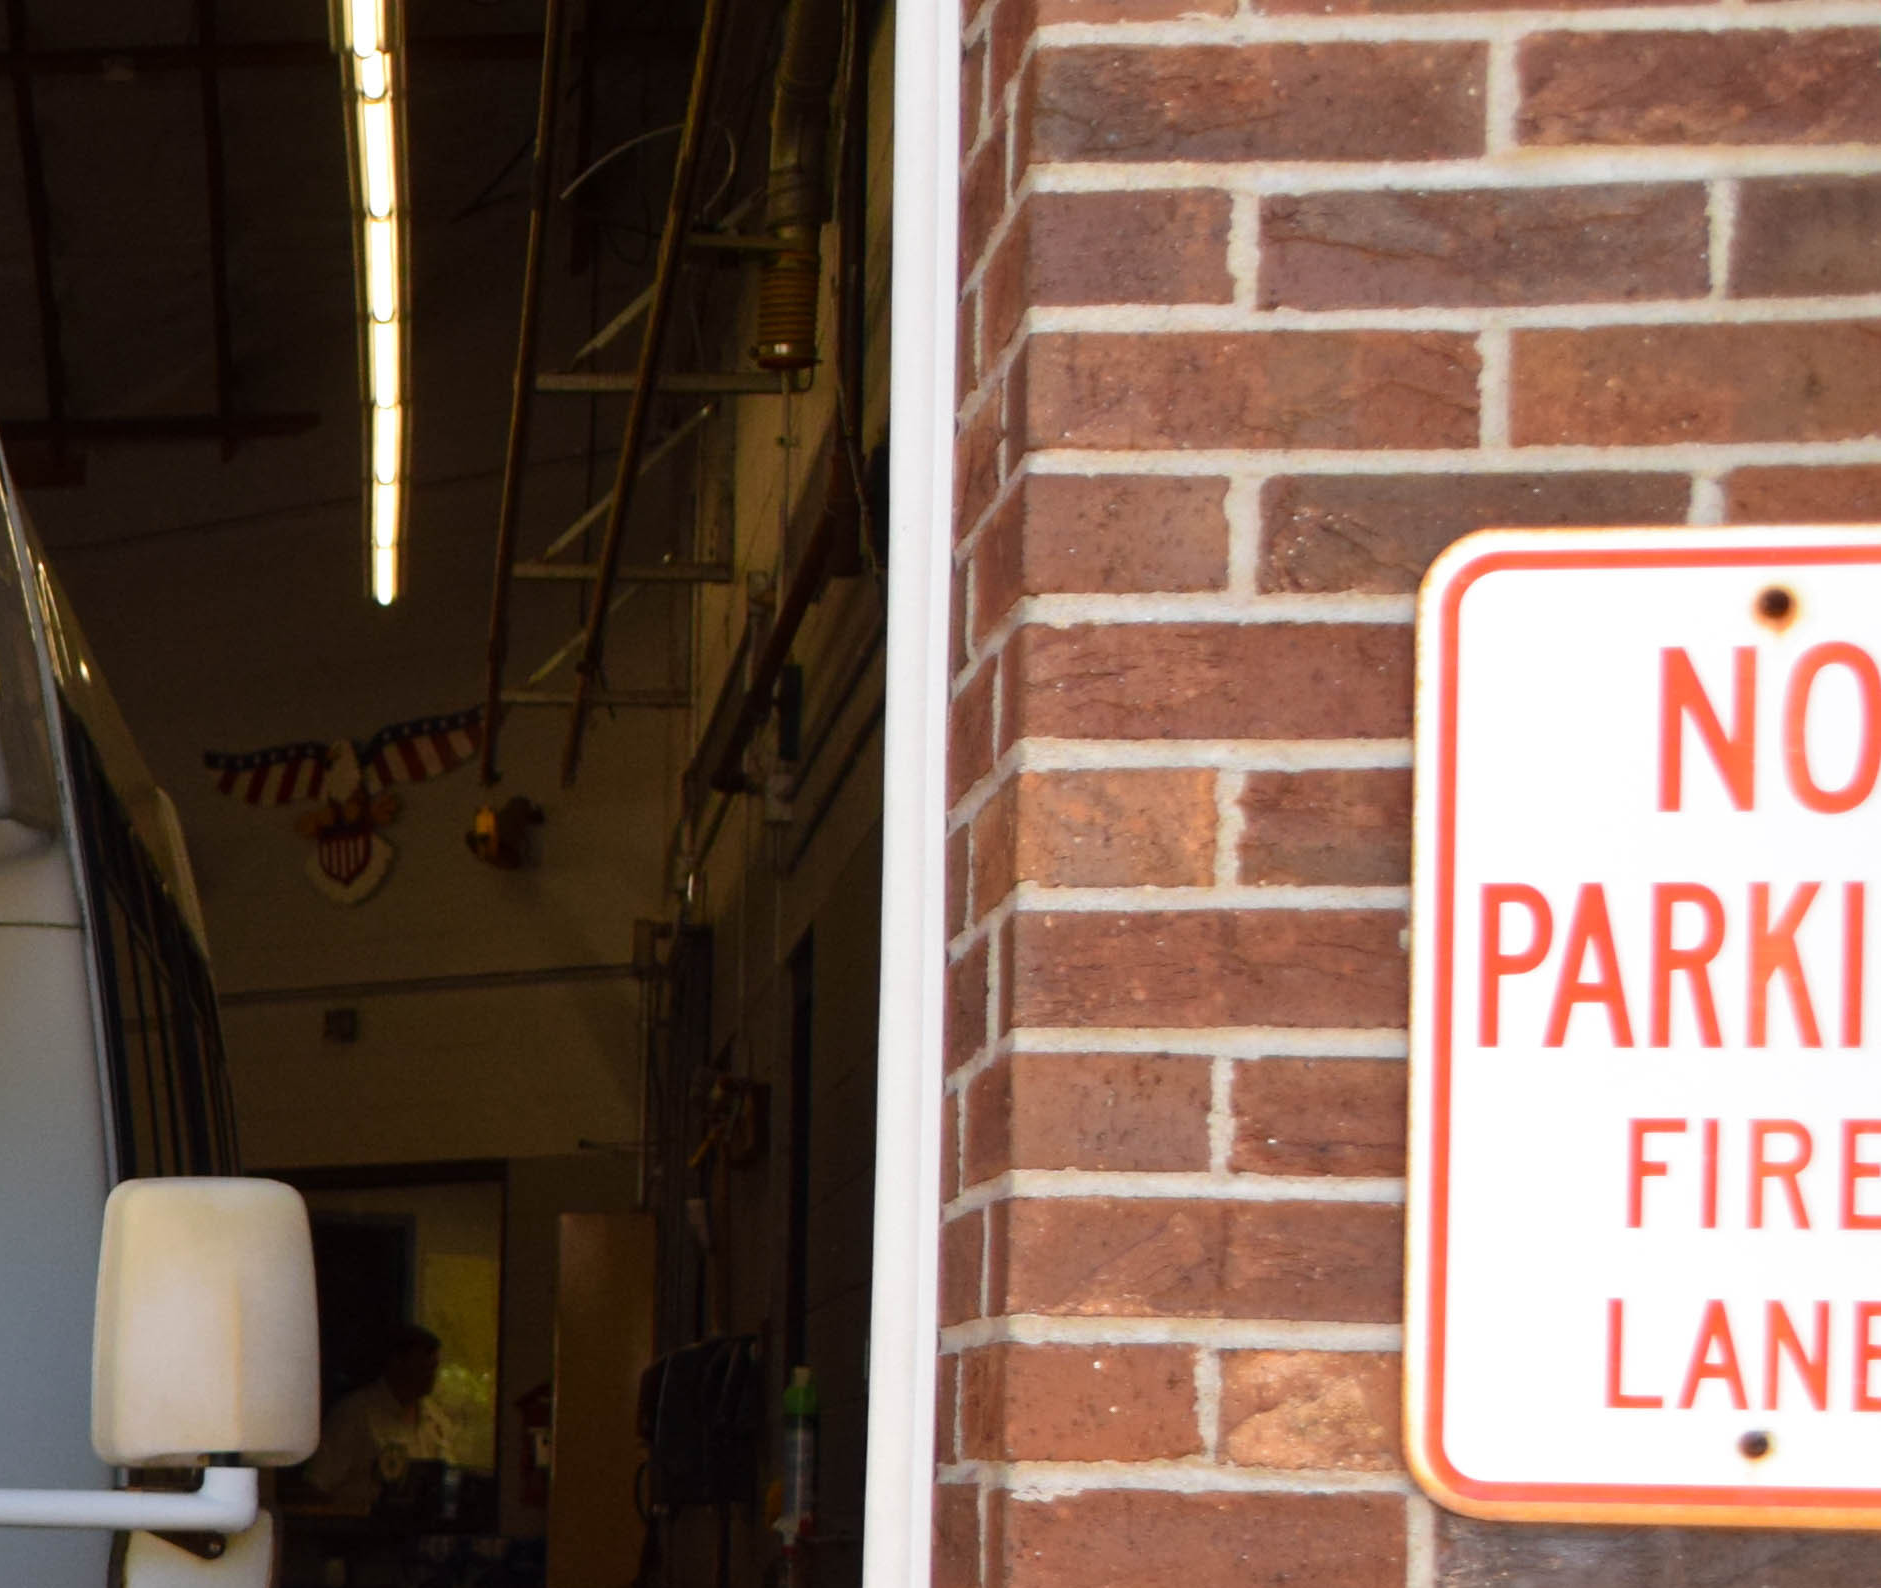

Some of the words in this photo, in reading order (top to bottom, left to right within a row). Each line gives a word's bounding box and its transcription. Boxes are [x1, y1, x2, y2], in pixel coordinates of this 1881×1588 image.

[1657, 640, 1881, 814] NO
[1478, 881, 1865, 1048] PARKI
[1626, 1117, 1881, 1230] FIRE
